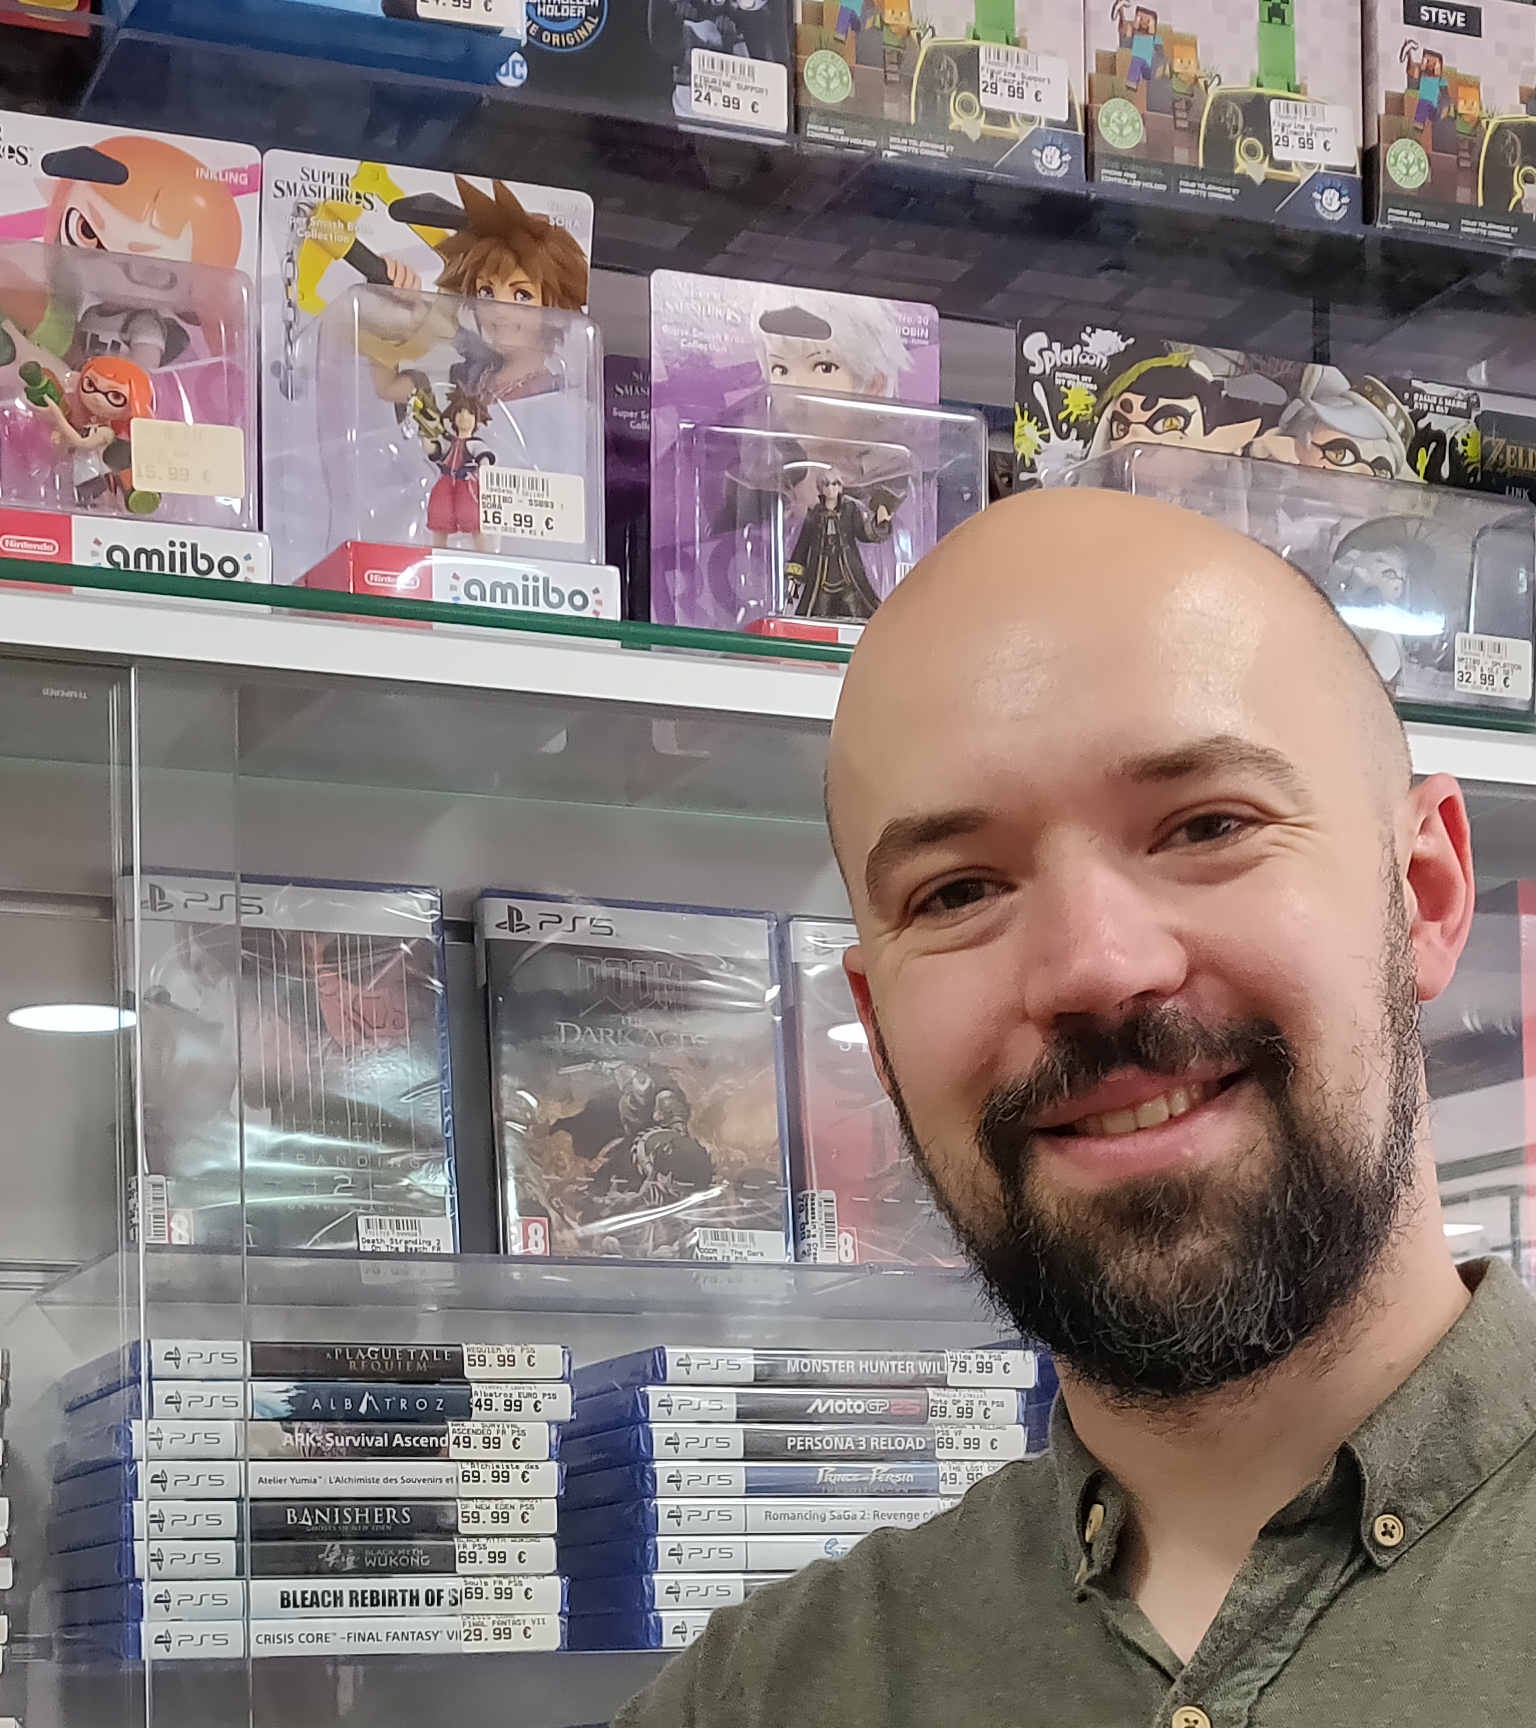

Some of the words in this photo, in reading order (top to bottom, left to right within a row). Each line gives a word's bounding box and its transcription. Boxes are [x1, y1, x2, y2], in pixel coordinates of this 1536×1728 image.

[1420, 6, 1466, 26] STEVE
[694, 91, 740, 111] 24.99
[750, 100, 759, 114] €
[1023, 330, 1109, 374] Splatoon
[1506, 486, 1530, 499] LINK
[482, 509, 536, 531] 16.99
[544, 516, 554, 532] €
[106, 542, 240, 578] amiibo
[464, 574, 589, 614] amiibo
[1457, 671, 1495, 686] 32.99
[1503, 676, 1510, 688] €
[539, 913, 616, 936] PS5
[187, 1352, 238, 1365] PS5
[334, 1348, 404, 1361] PLAGUE
[407, 1348, 451, 1361] TALE
[467, 1354, 516, 1368] 59.99
[527, 1355, 535, 1367] €
[349, 1359, 428, 1372] REQUIEM
[474, 1391, 513, 1399] Albatroz
[788, 1437, 854, 1449] PERSONA
[858, 1437, 866, 1449] 3
[870, 1437, 925, 1449] RELOAD
[287, 1508, 411, 1524] BANISHERS
[365, 1554, 430, 1567] WUKONG
